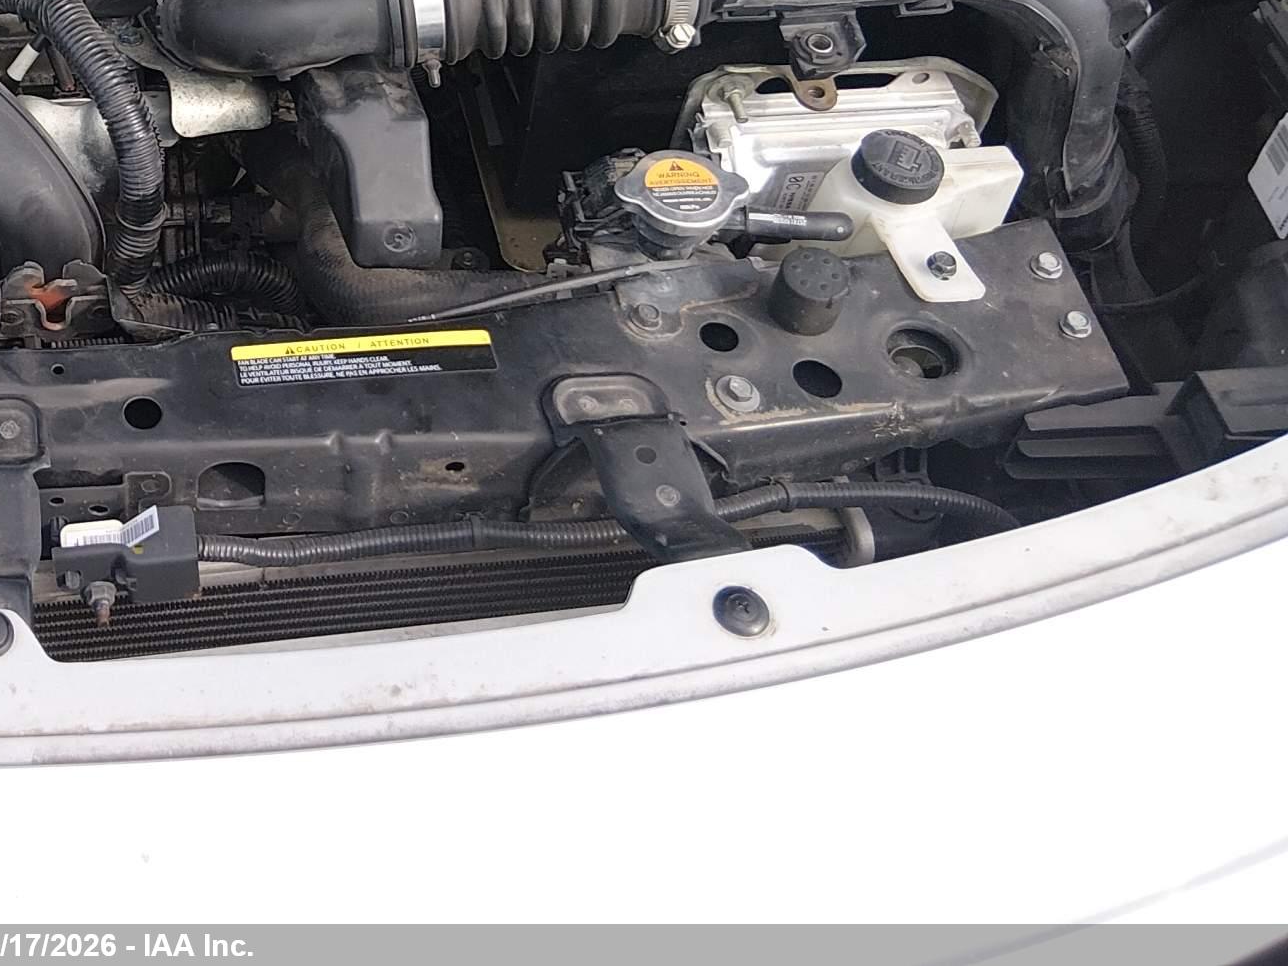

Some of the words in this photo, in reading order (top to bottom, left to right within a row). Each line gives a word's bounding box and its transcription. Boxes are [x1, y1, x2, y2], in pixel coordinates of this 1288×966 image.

[649, 178, 713, 186] AVERTISSEMENT
[658, 171, 700, 179] WARNING
[296, 343, 345, 354] CAUTION
[371, 338, 429, 348] ATTENTION
[248, 368, 289, 377] VENTILATEUR
[382, 360, 412, 368] MOMENT.
[303, 372, 336, 380] BLESSURE,
[369, 366, 406, 375] APPROCHER
